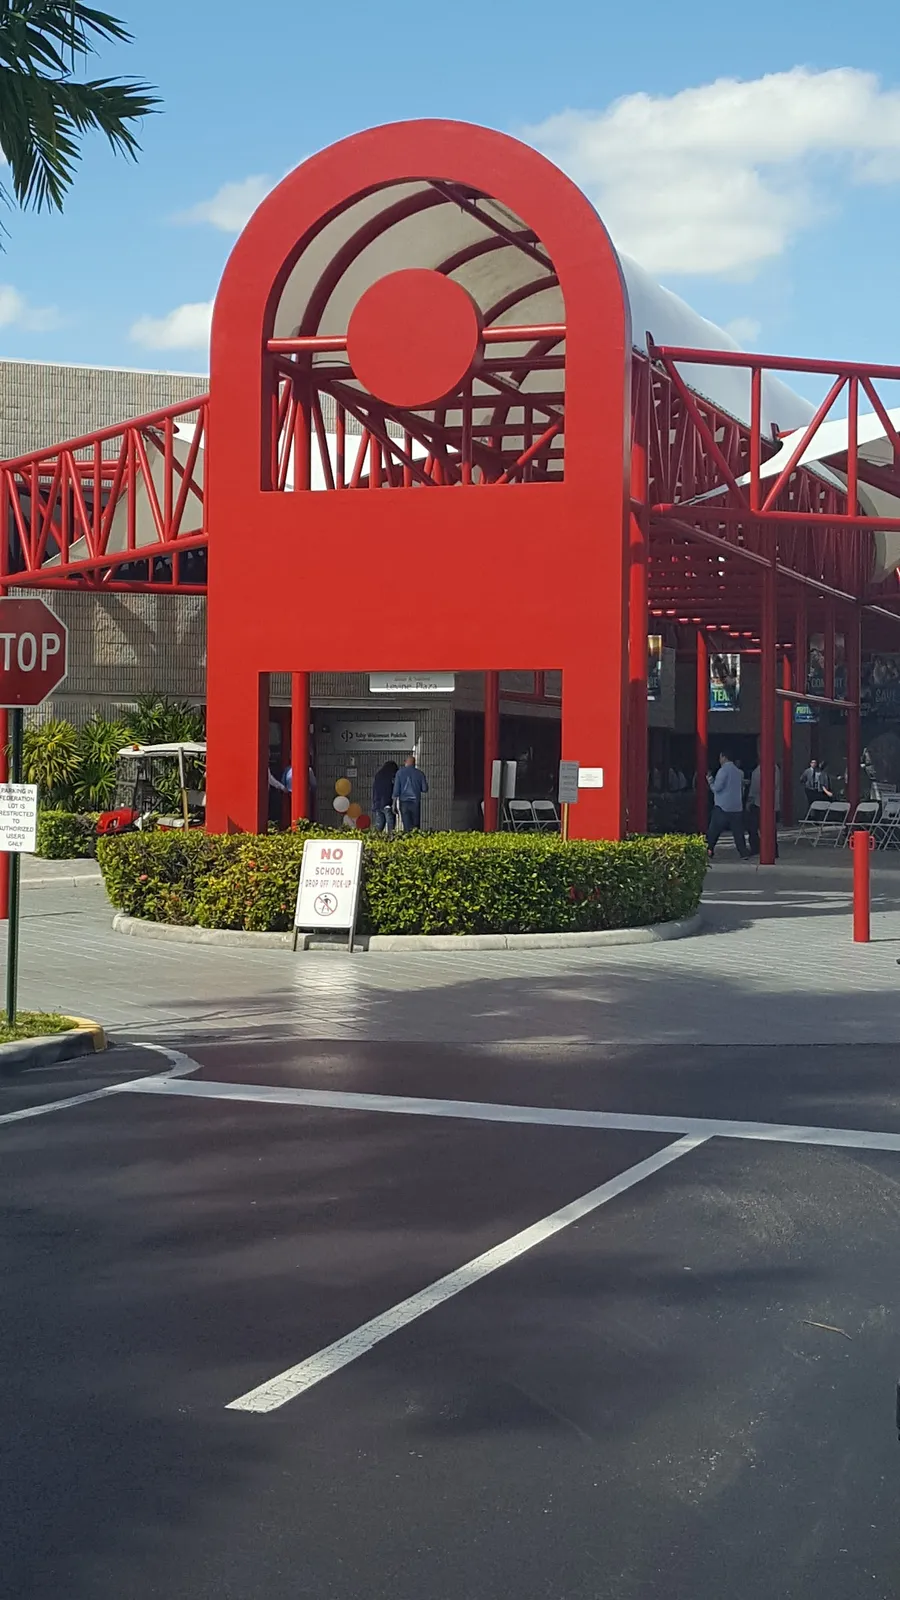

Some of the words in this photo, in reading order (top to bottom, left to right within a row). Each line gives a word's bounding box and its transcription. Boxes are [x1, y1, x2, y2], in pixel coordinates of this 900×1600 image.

[0, 632, 60, 672] TOP
[416, 682, 438, 690] Plaza
[321, 848, 343, 860] NO
[315, 867, 344, 875] SCHOOL
[305, 879, 318, 888] DROP
[320, 879, 329, 888] OFF
